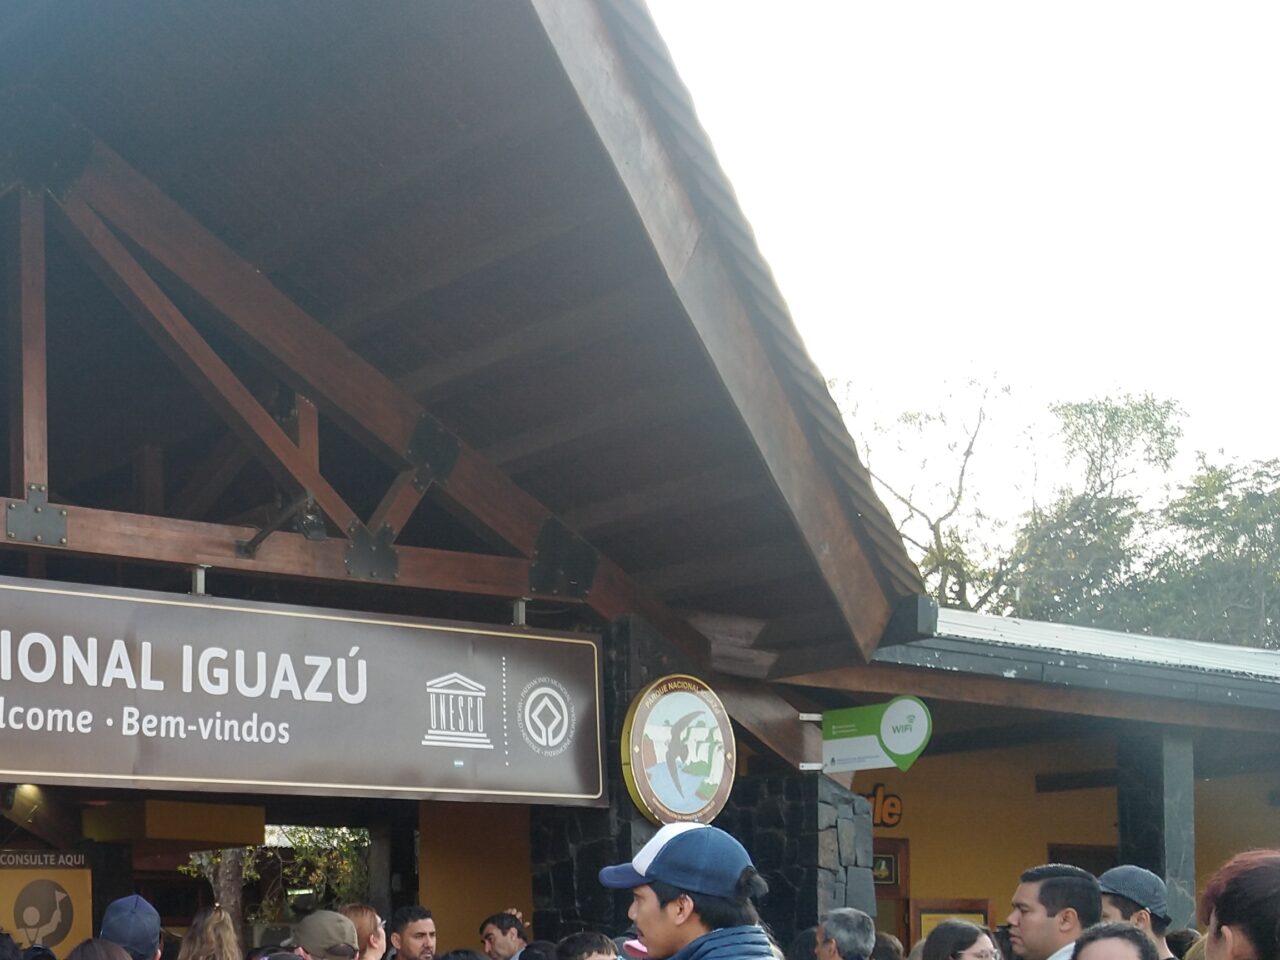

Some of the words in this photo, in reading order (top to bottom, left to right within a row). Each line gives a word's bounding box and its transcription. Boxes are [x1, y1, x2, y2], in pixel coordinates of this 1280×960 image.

[181, 646, 369, 705] IGUAZÚ
[645, 684, 669, 709] PARQUE
[668, 680, 699, 694] NACIONAL
[122, 705, 291, 745] Bem-vindos
[429, 692, 484, 733] UNESCO
[0, 854, 55, 865] CONSULTE
[58, 854, 85, 867] AQUI
